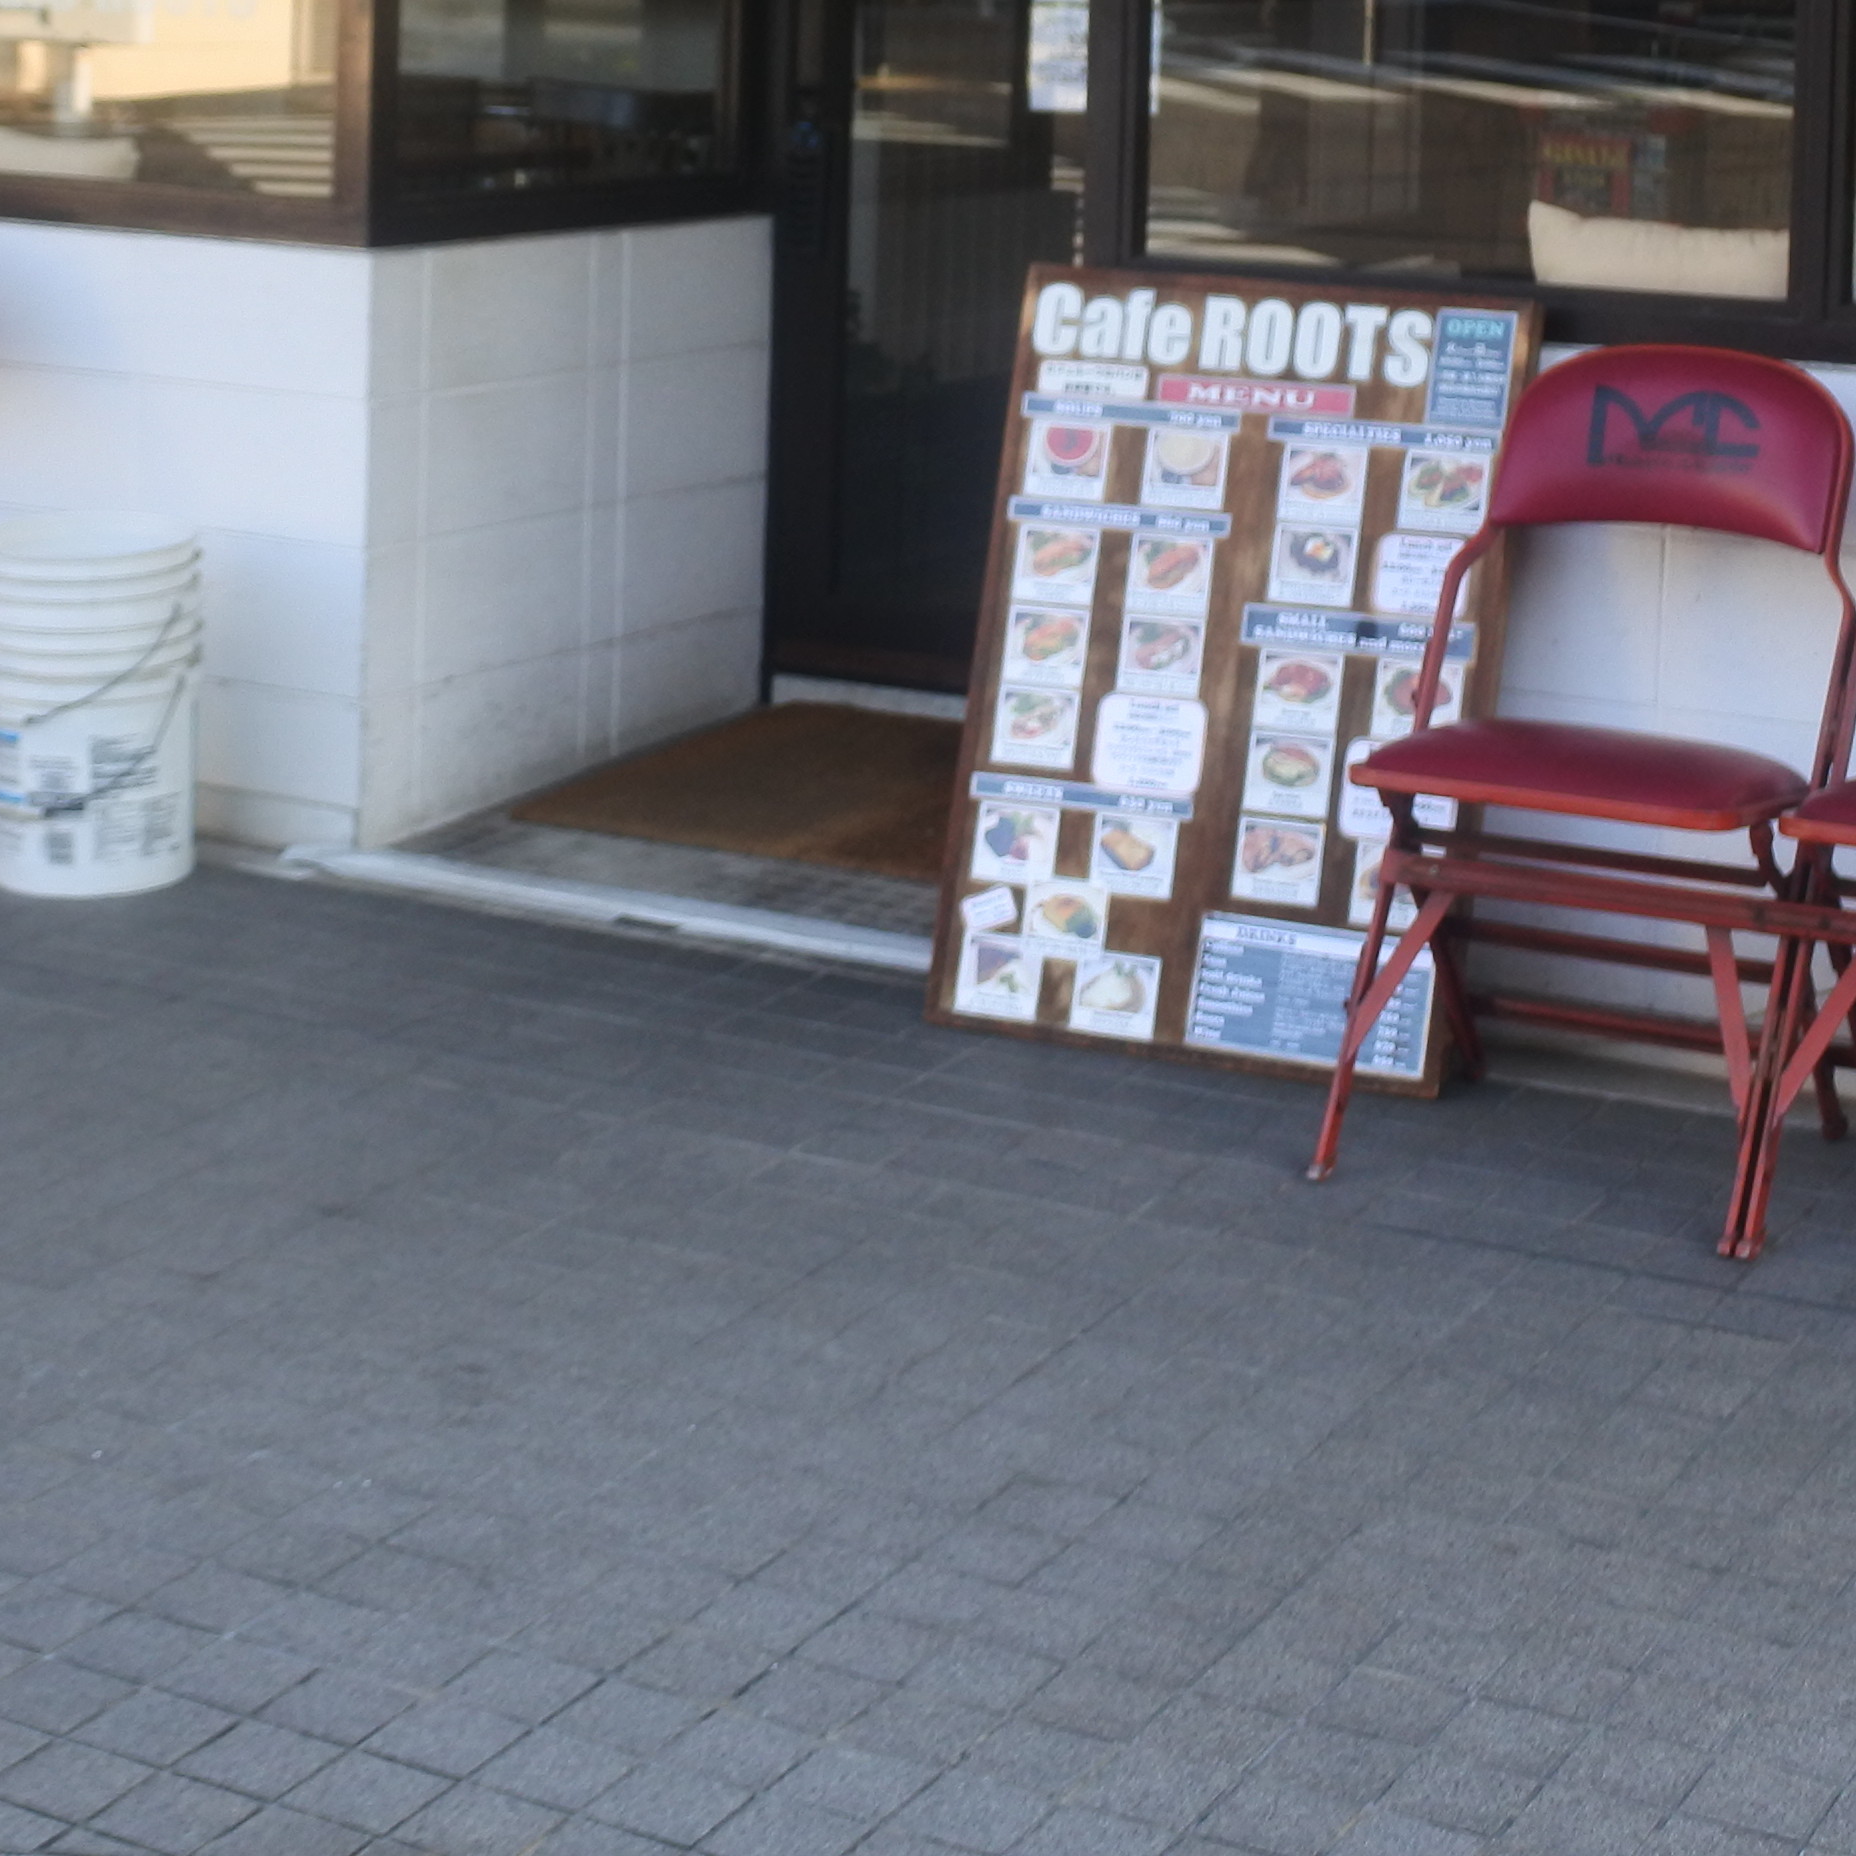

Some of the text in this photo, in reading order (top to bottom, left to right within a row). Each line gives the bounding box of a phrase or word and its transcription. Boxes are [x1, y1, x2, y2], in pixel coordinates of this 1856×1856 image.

[1032, 281, 1194, 366] Cafe
[1197, 293, 1434, 389] ROOTS
[1445, 317, 1506, 338] OPEN
[1187, 381, 1316, 410] MENU
